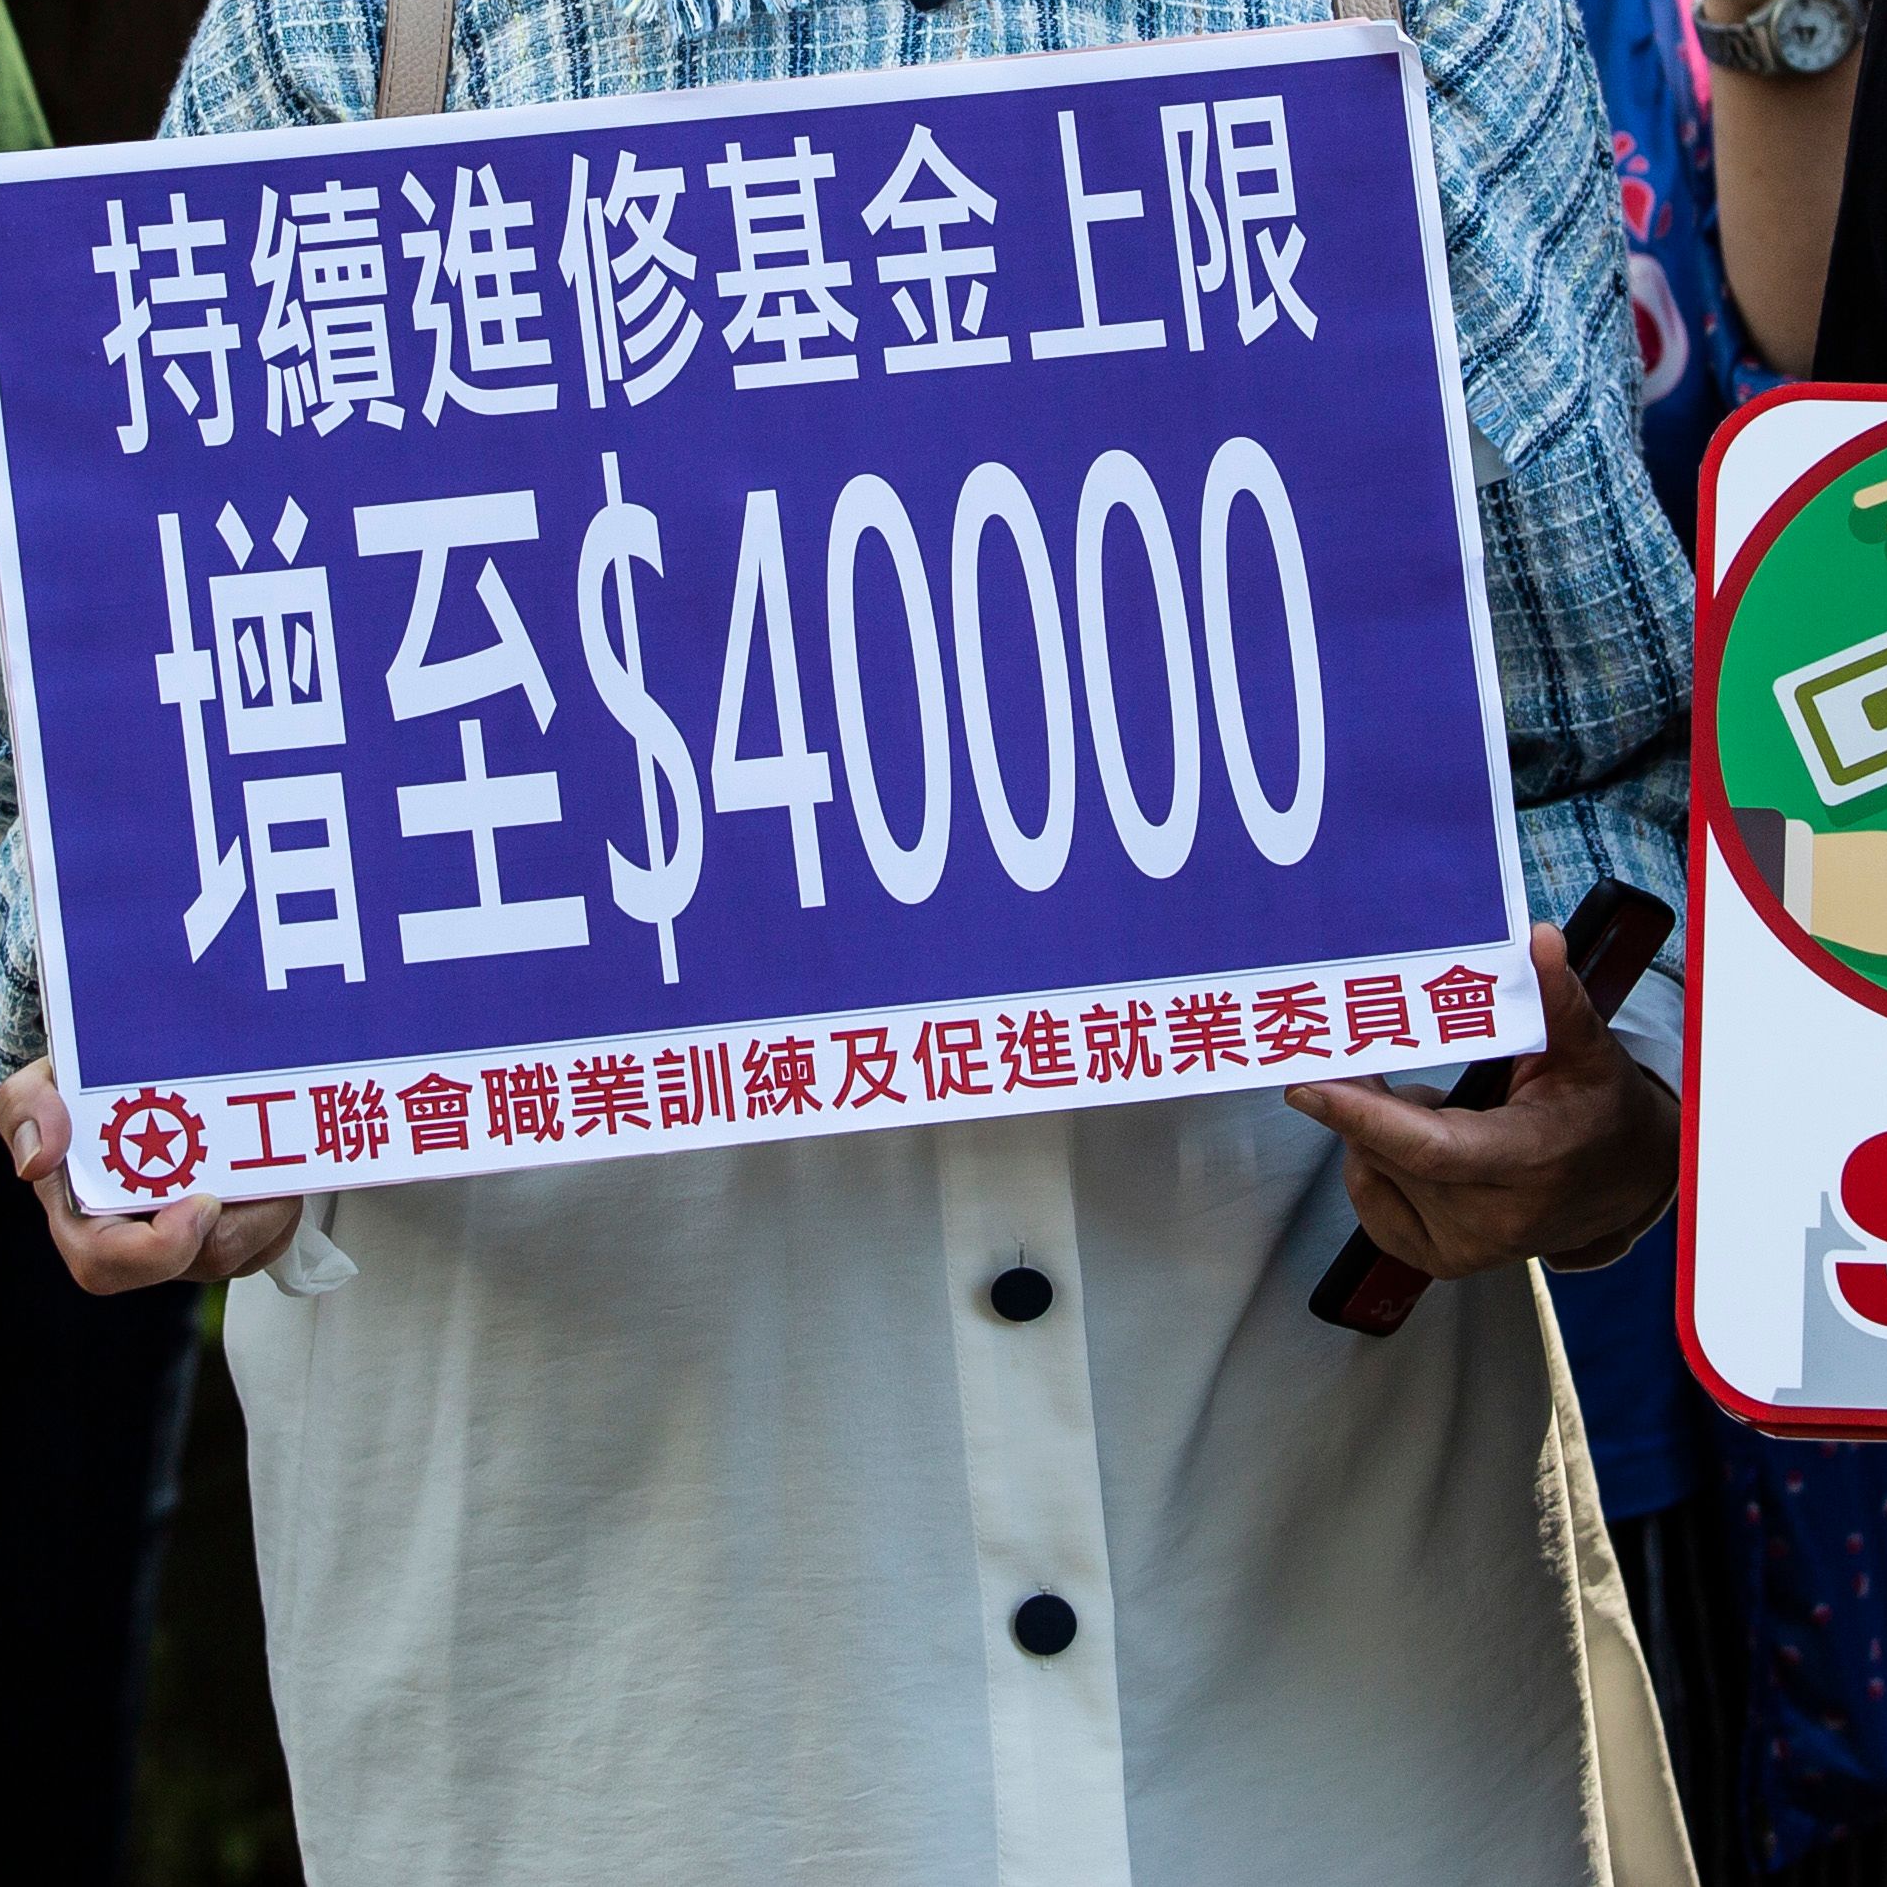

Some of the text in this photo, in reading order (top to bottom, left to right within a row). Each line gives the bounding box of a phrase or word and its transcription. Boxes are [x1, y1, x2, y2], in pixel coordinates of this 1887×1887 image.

[91, 94, 1318, 455] 持續進修基金上限
[156, 436, 1327, 992] 增至$40000
[228, 964, 1501, 1174] 工聯會職業訓練及促進就業委員會
